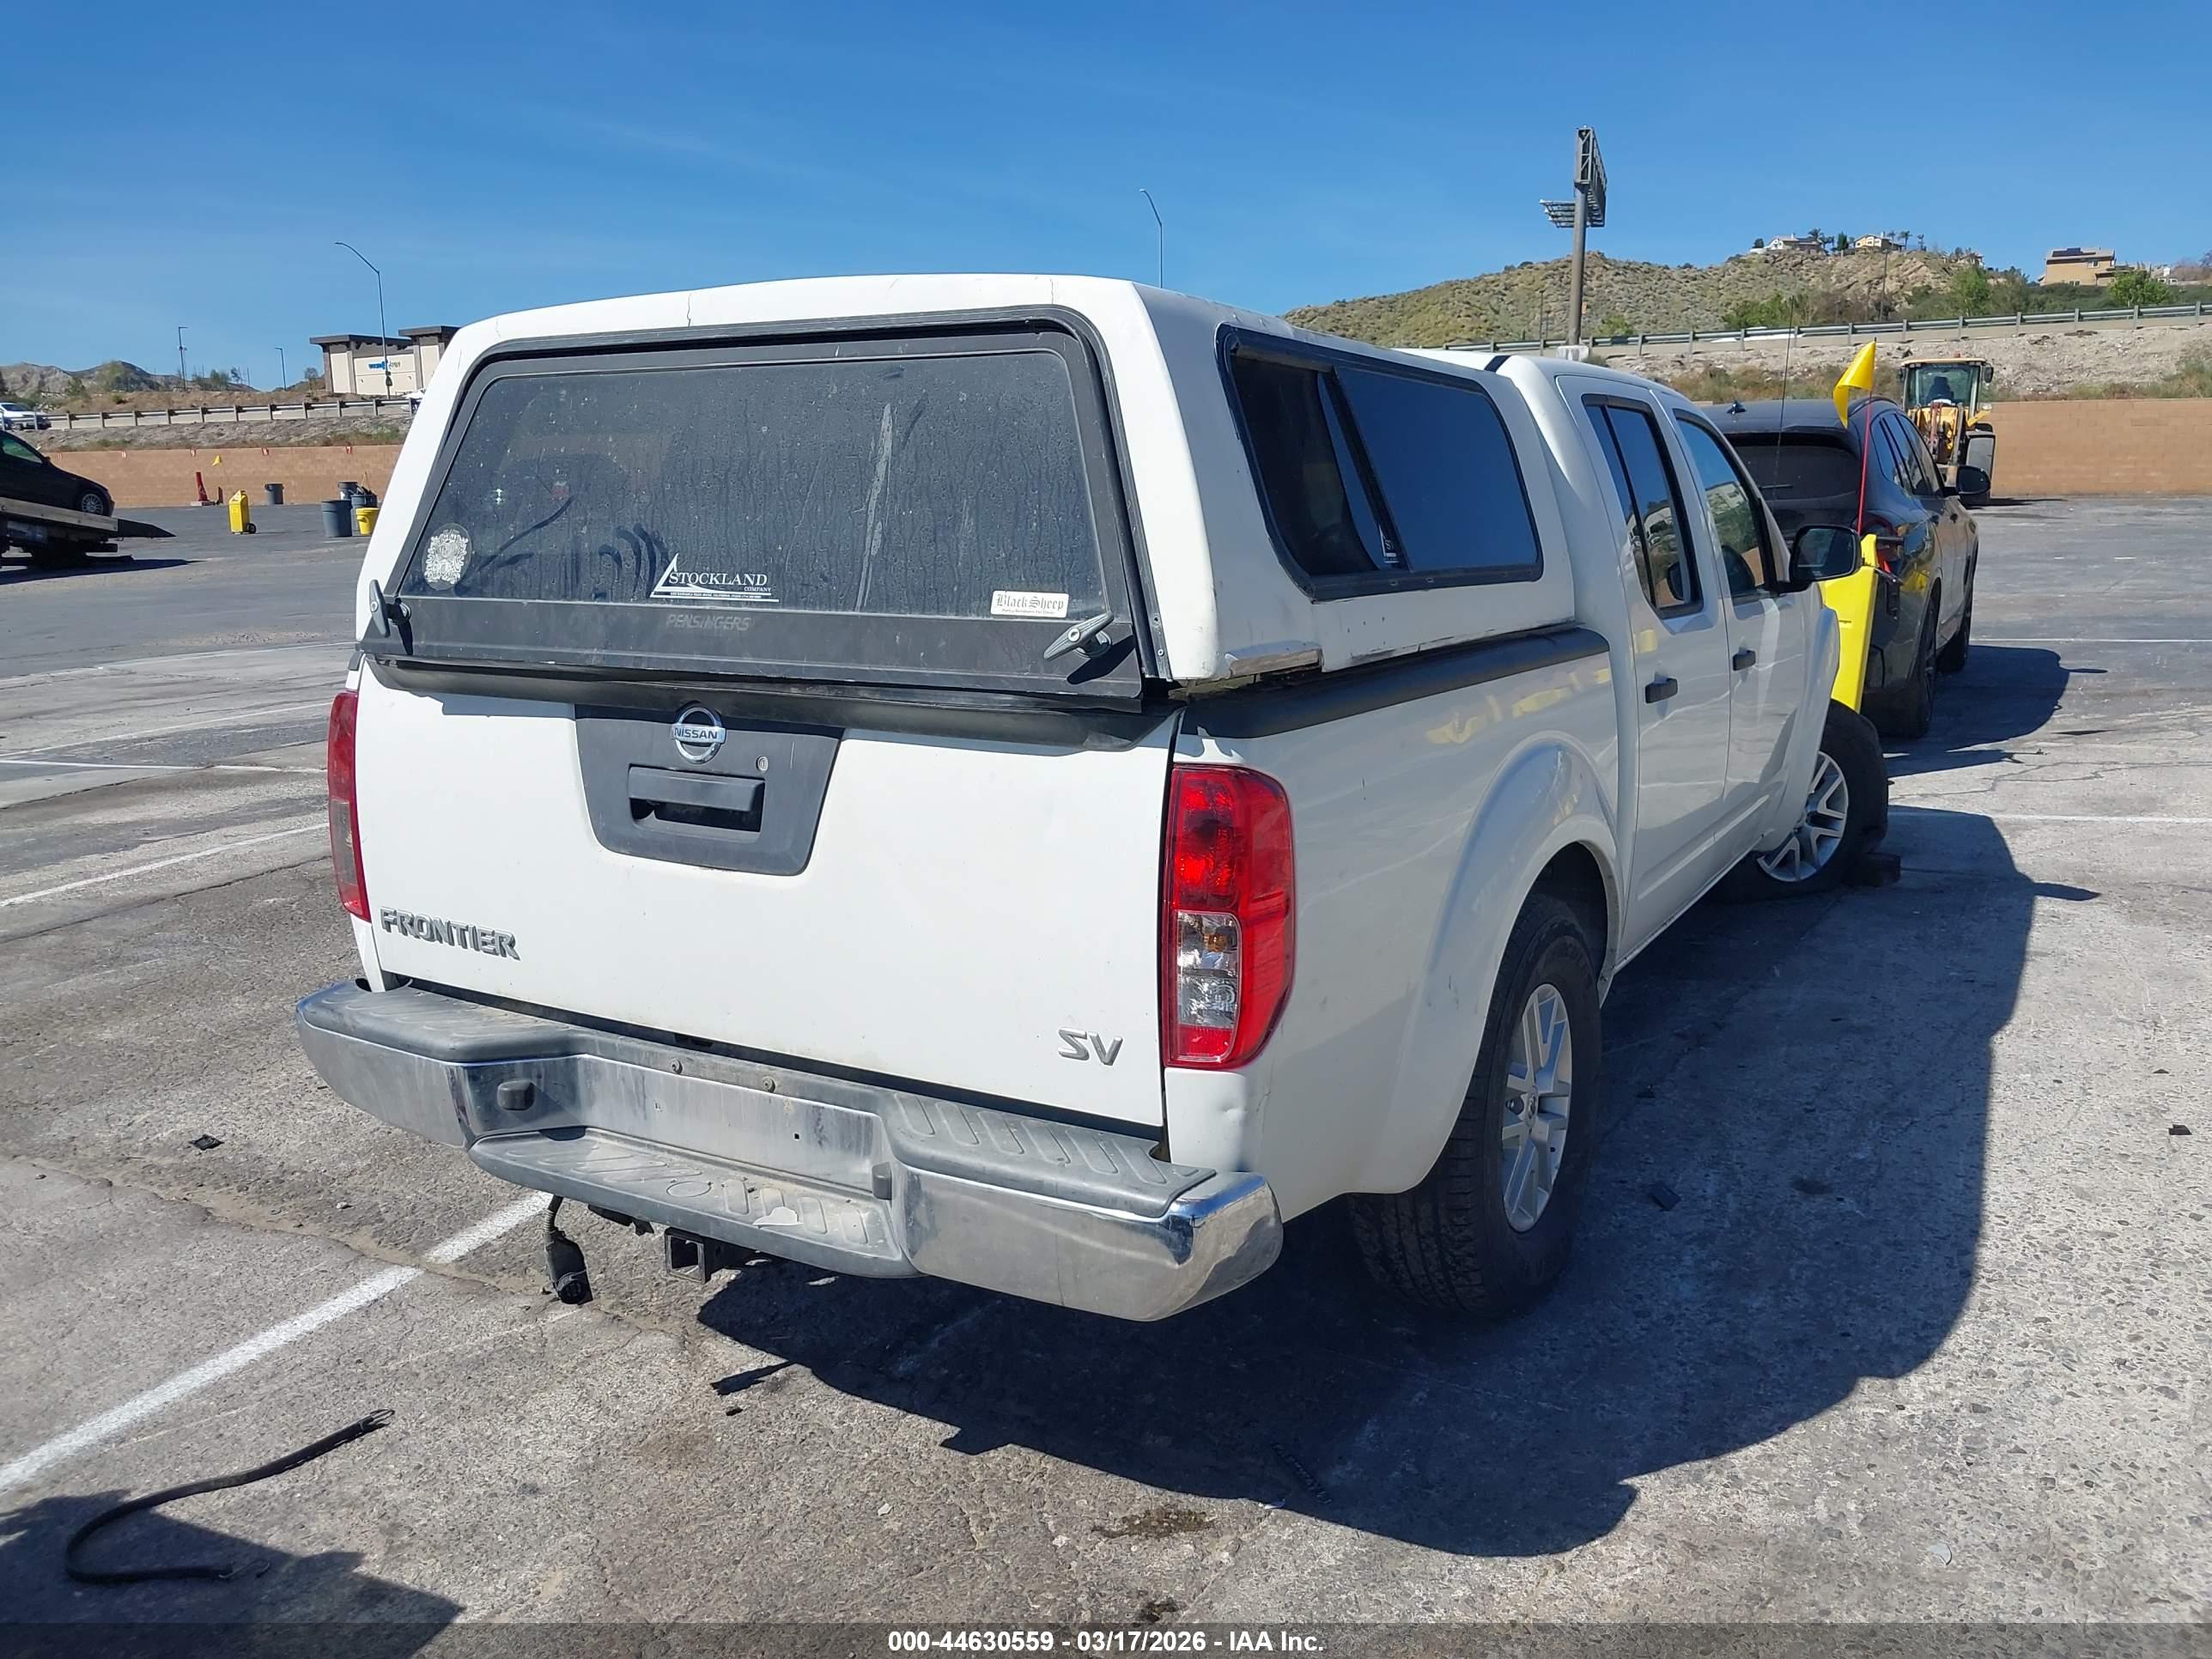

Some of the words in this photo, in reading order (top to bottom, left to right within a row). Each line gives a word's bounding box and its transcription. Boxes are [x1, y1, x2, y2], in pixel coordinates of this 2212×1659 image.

[668, 572, 768, 586] STOCKLAND
[674, 727, 718, 739] NISSAN
[380, 907, 521, 961] FRONTIER
[1058, 1027, 1123, 1066] SV
